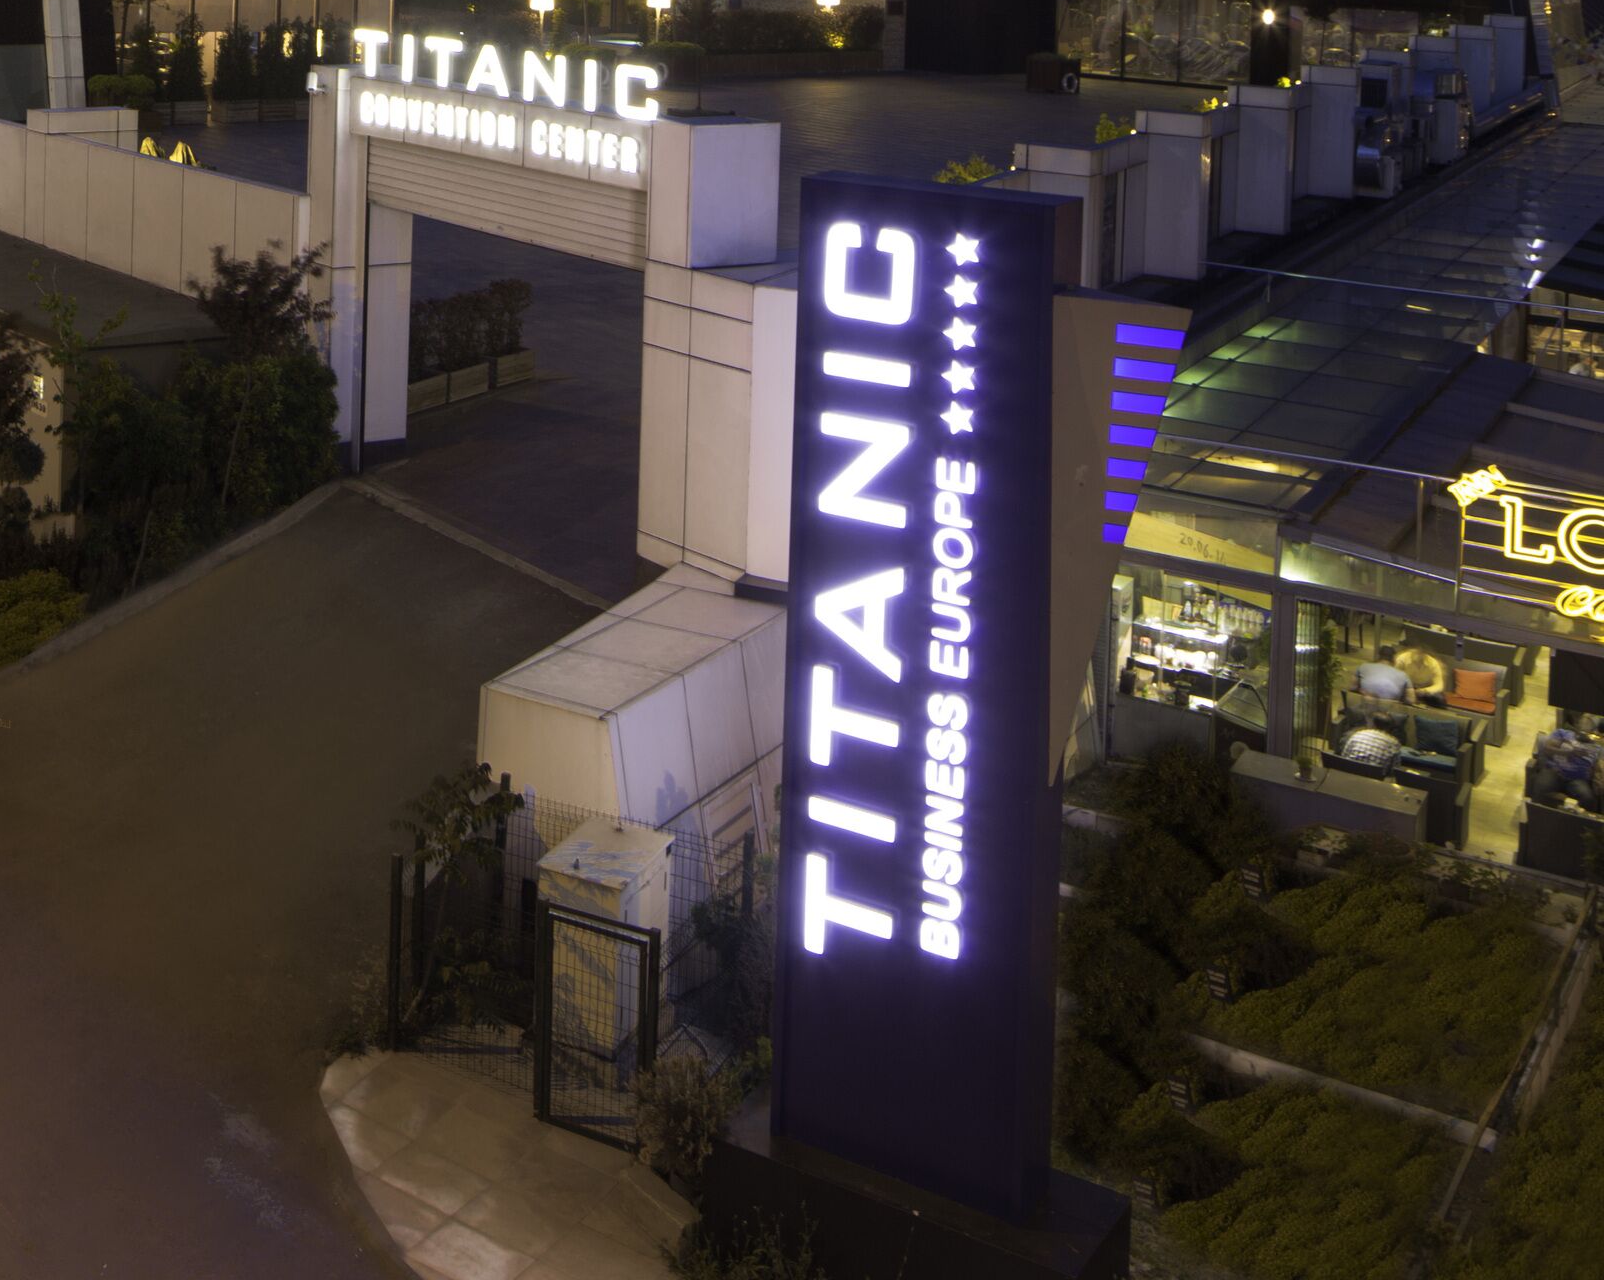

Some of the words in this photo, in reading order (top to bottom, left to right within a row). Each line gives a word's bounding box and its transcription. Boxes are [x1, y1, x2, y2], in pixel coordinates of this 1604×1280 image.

[354, 28, 659, 122] TITANIC
[359, 90, 517, 150] CONVENTION
[530, 118, 640, 175] CENTER
[802, 220, 916, 956] TITANIC
[929, 456, 977, 681] EUROPE
[918, 692, 970, 961] BUSINESS
